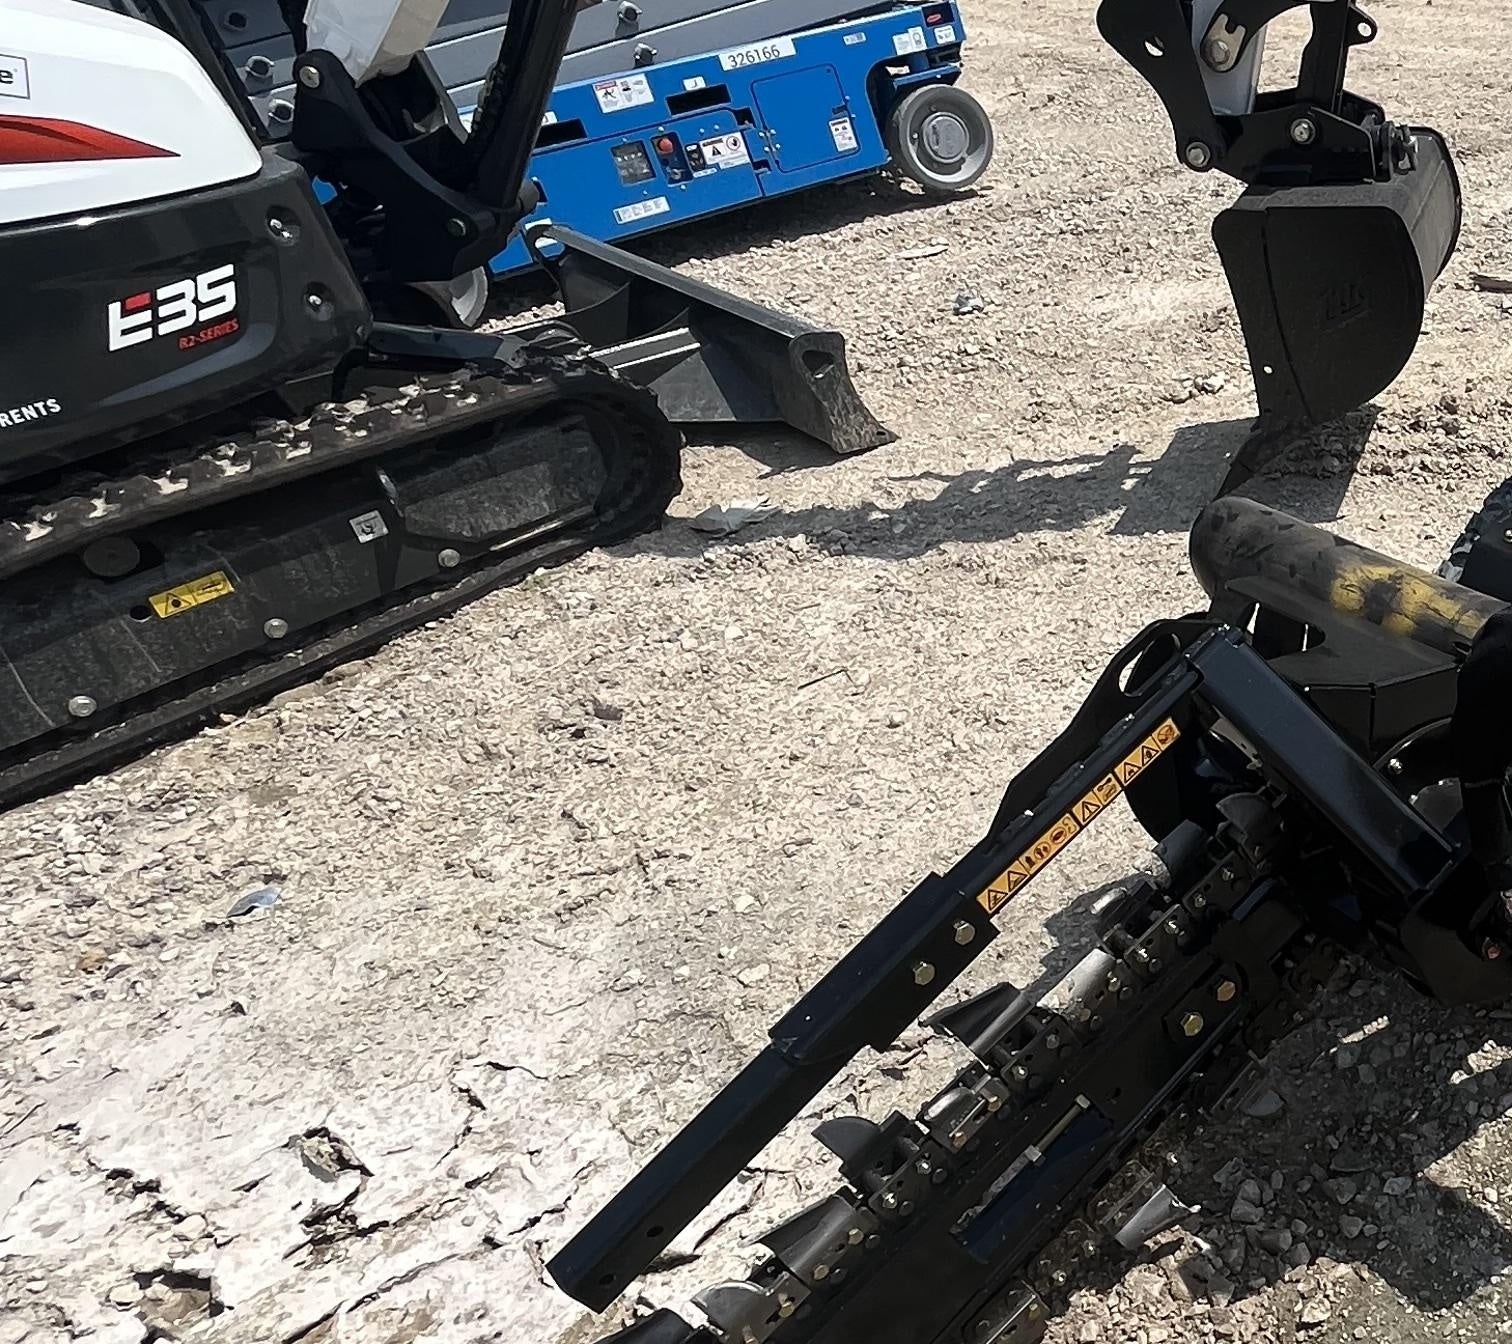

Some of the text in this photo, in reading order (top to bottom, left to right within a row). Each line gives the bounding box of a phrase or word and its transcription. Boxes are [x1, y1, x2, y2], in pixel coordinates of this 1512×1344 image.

[727, 43, 781, 68] 326166
[107, 263, 237, 352] E35
[179, 318, 240, 350] R2-SERIES
